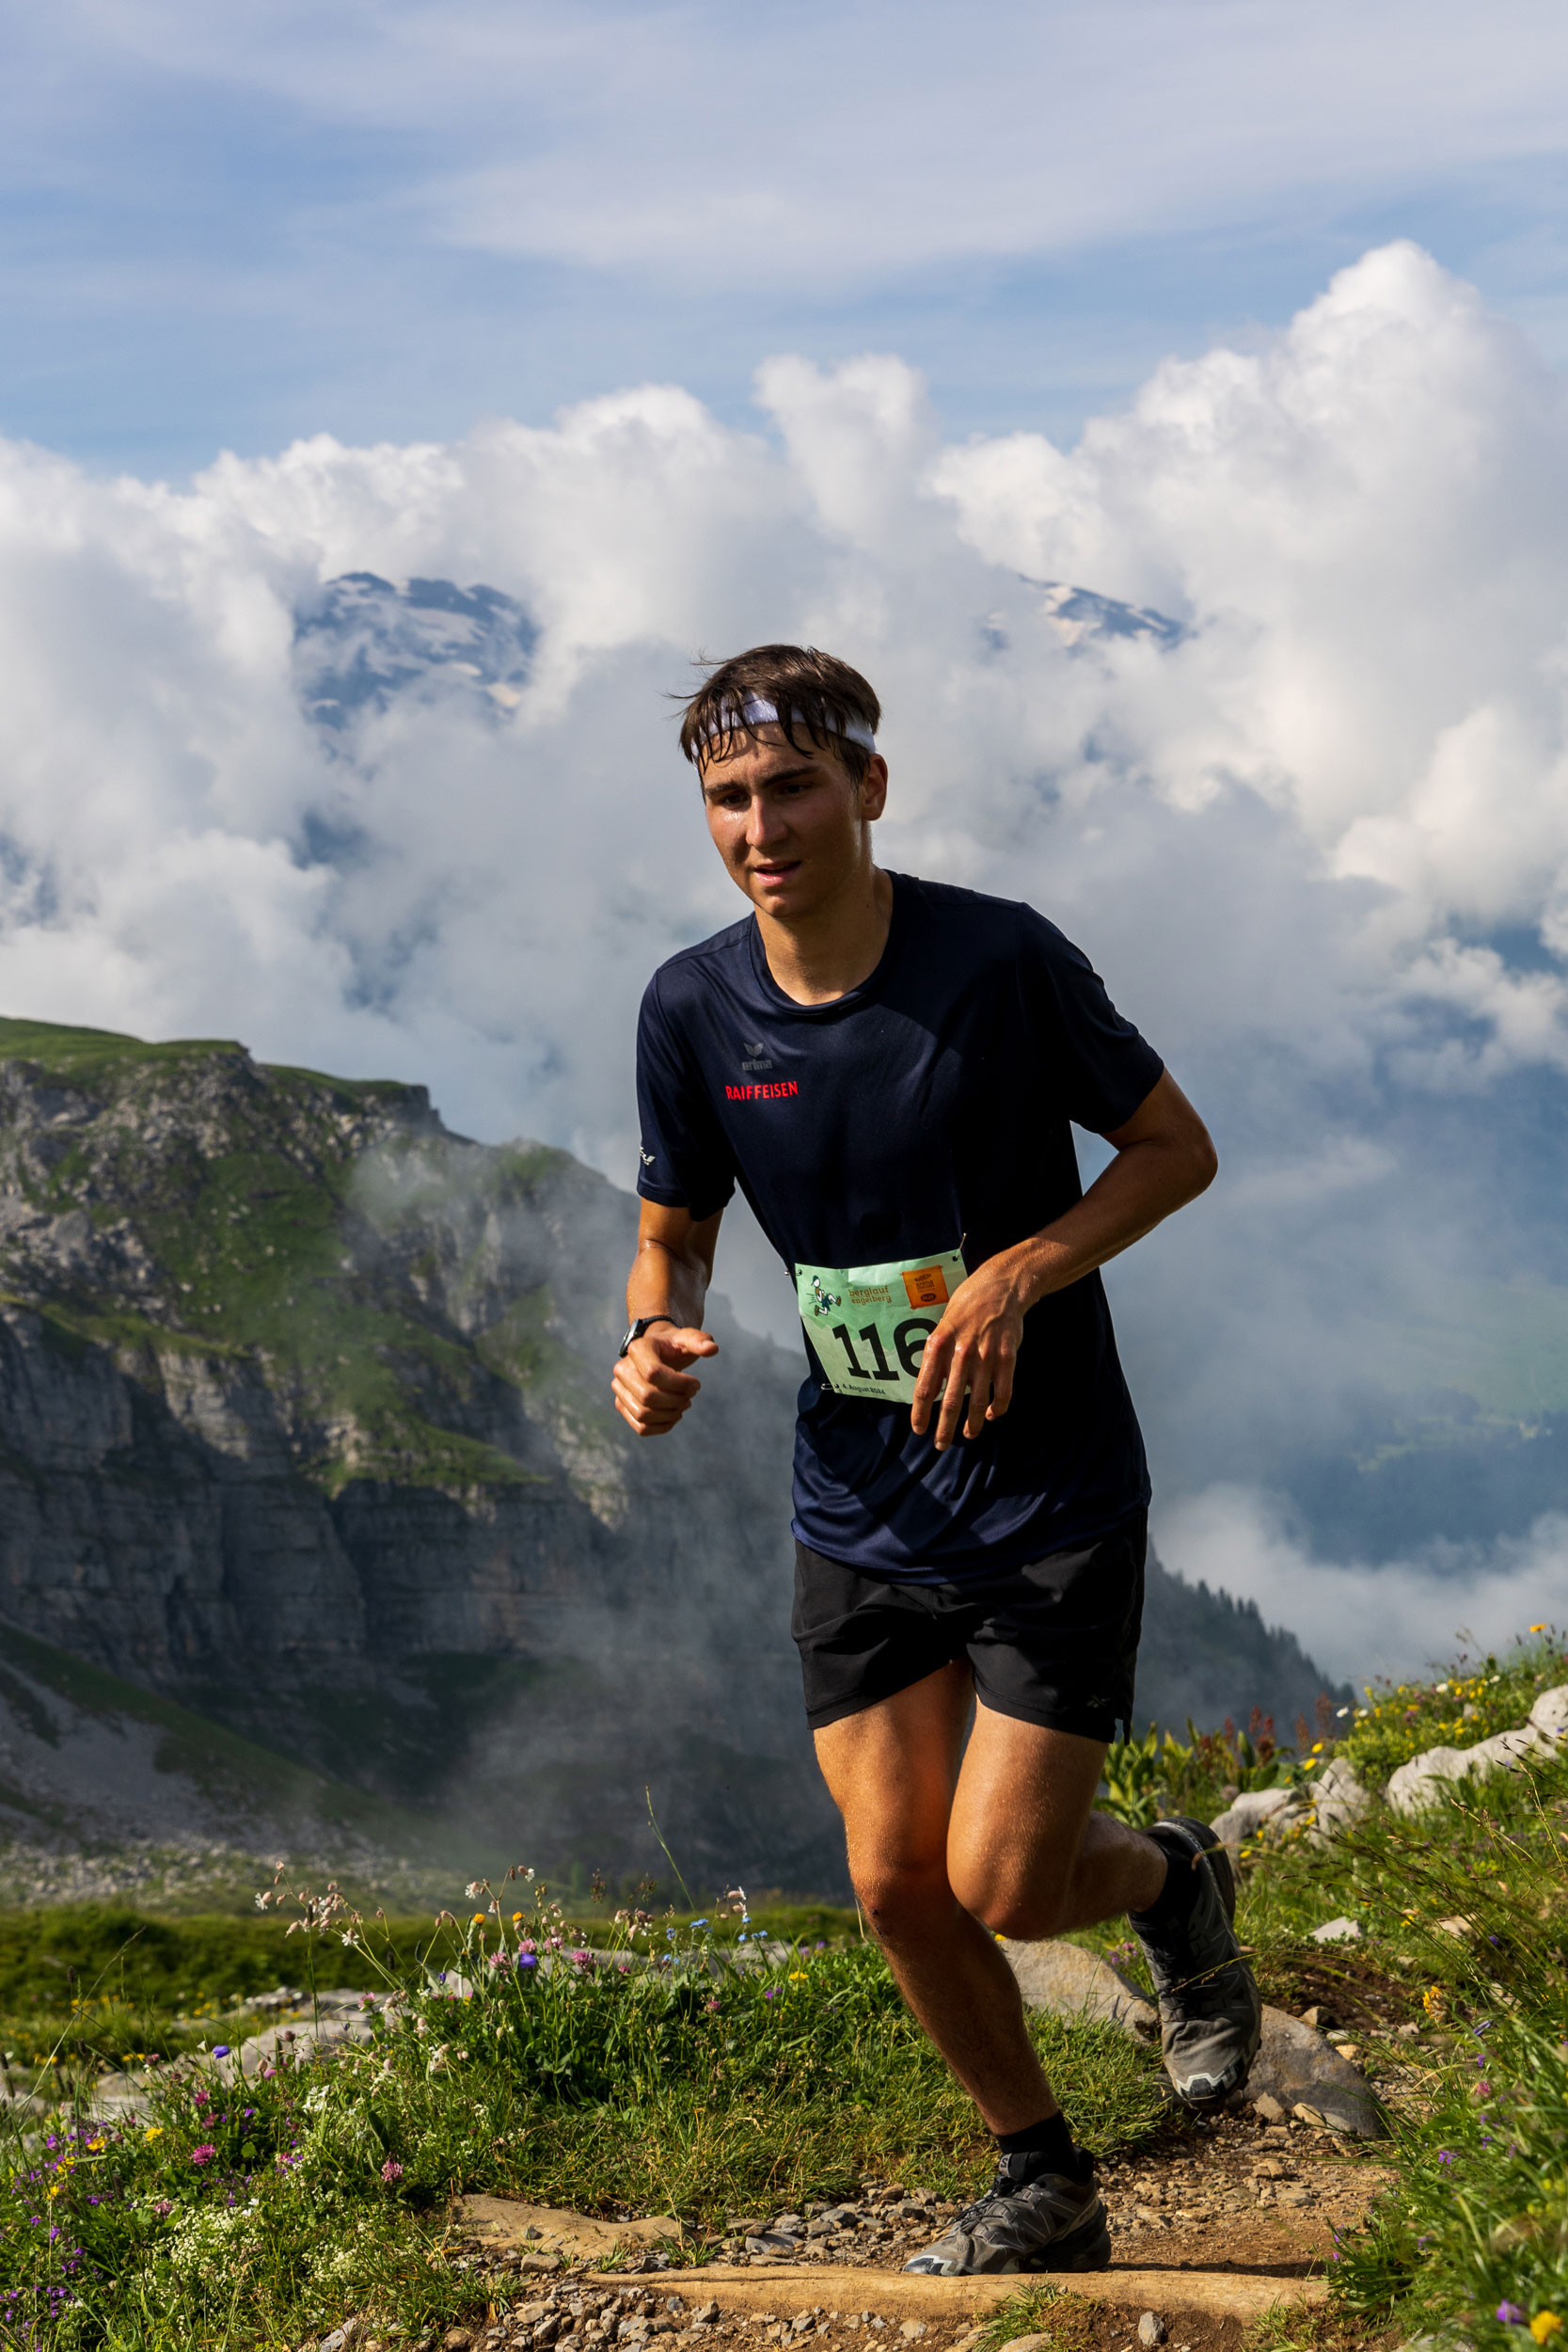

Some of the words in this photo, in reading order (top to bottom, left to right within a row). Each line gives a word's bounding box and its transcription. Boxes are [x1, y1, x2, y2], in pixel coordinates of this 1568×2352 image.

[742, 1059, 772, 1071] erima
[725, 1081, 798, 1100] RAIFFEISEN
[848, 1285, 888, 1297] berglauf
[851, 1295, 892, 1306] engelberg
[832, 1318, 939, 1380] 116
[848, 1384, 870, 1392] August
